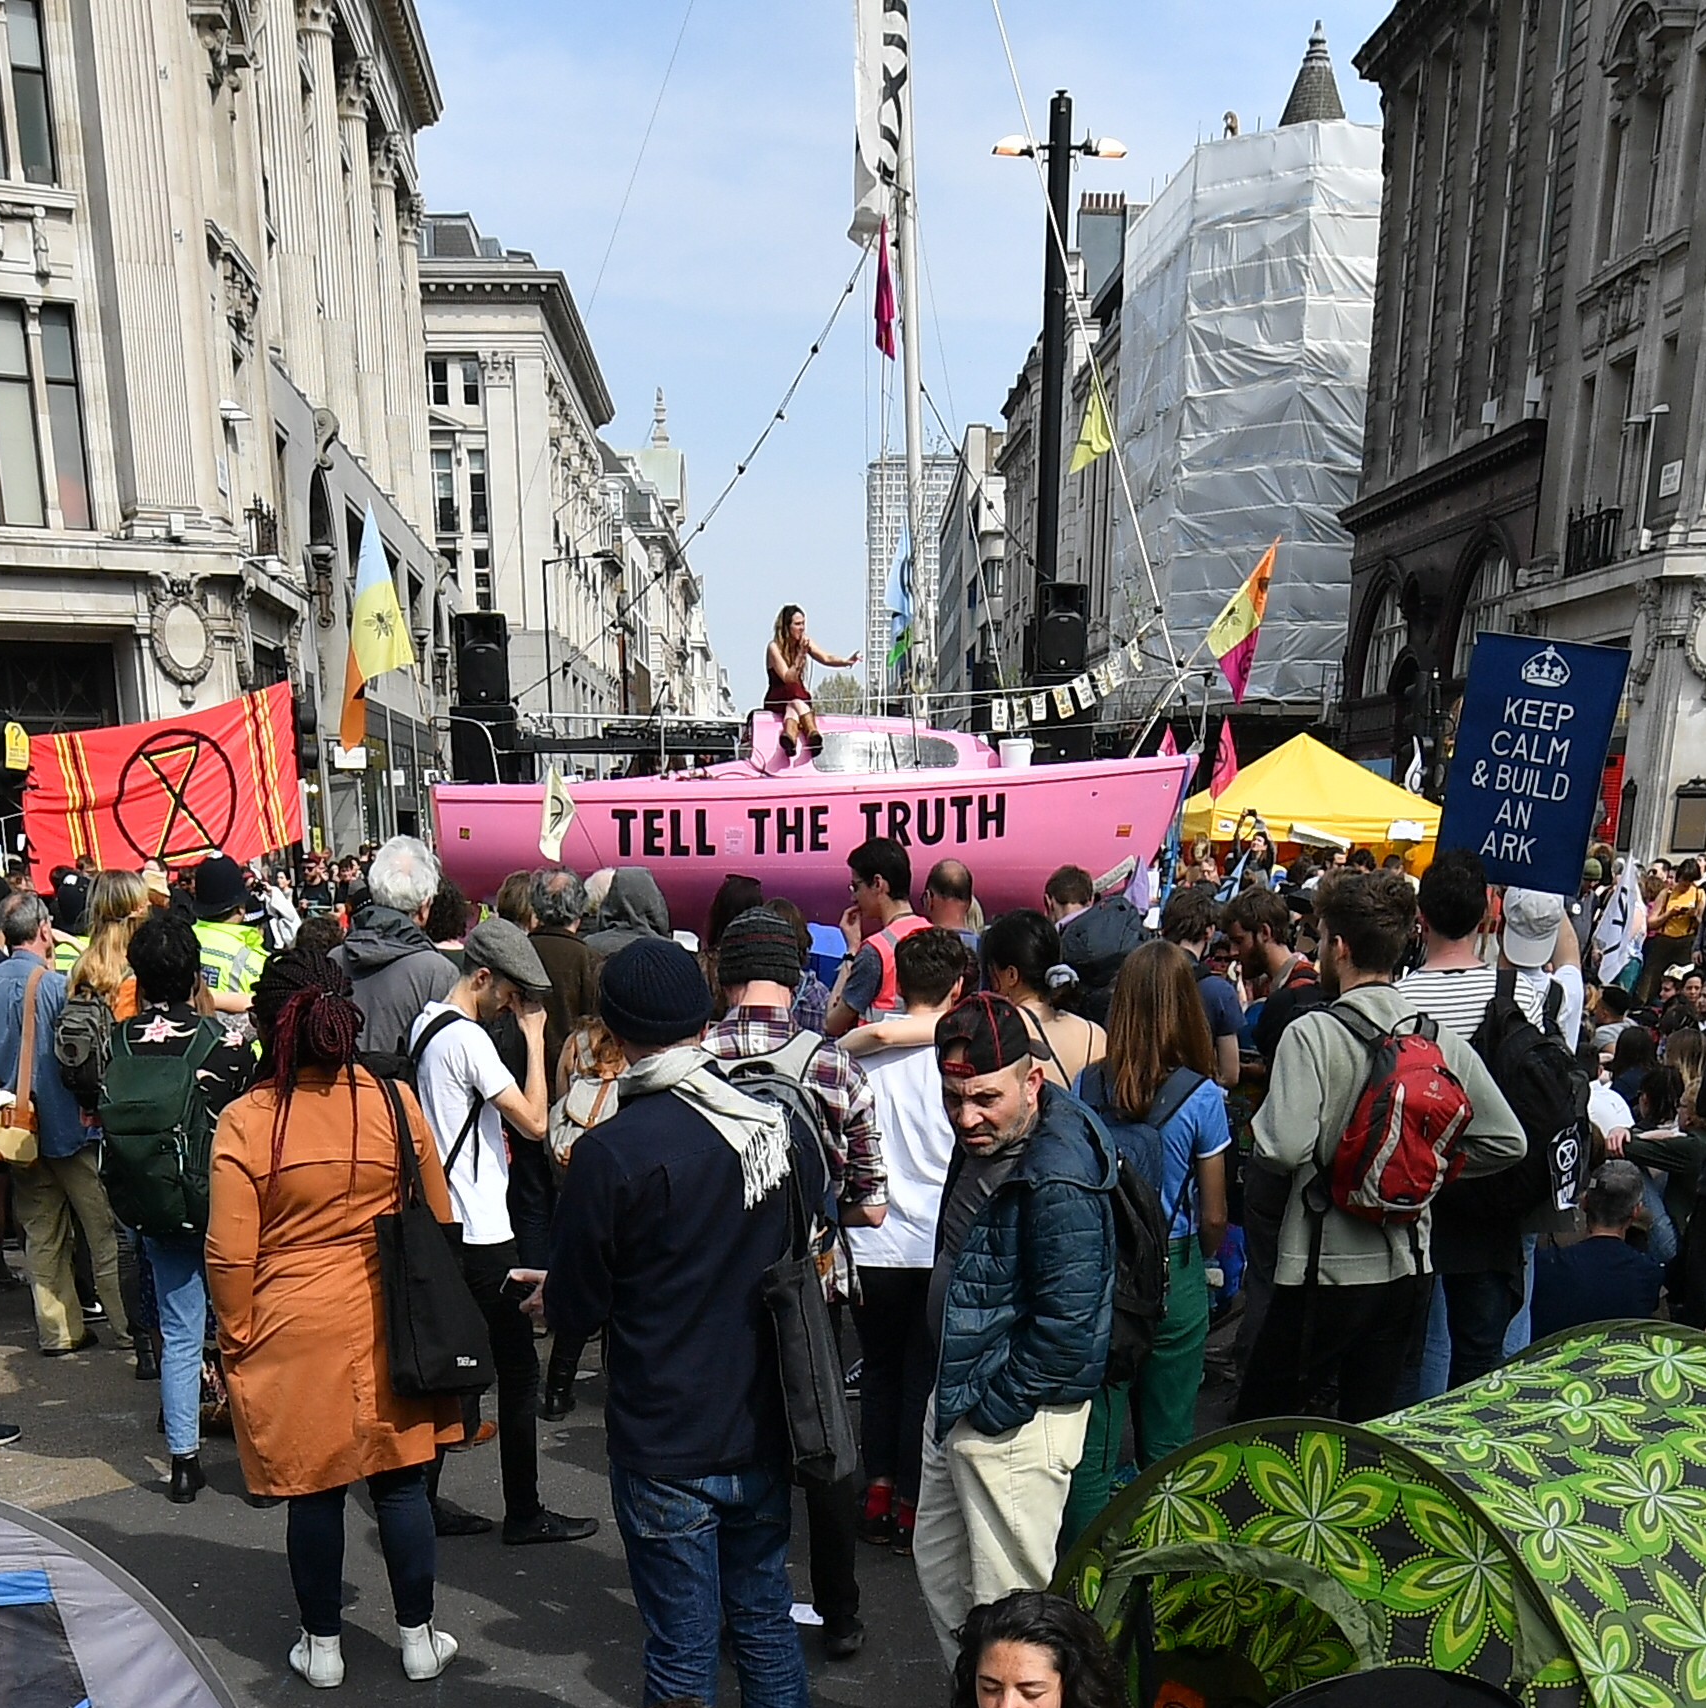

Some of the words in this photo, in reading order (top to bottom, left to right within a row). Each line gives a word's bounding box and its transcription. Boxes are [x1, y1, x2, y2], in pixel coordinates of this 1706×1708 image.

[1503, 696, 1575, 731] KEEP
[1491, 730, 1571, 767] CALM
[1472, 759, 1489, 788] &
[1495, 763, 1570, 801] BUILD
[611, 809, 716, 857] TELL
[747, 805, 830, 855] THE
[860, 793, 1006, 847] TRUTH
[1494, 798, 1533, 830] AN
[1479, 830, 1537, 864] ARK
